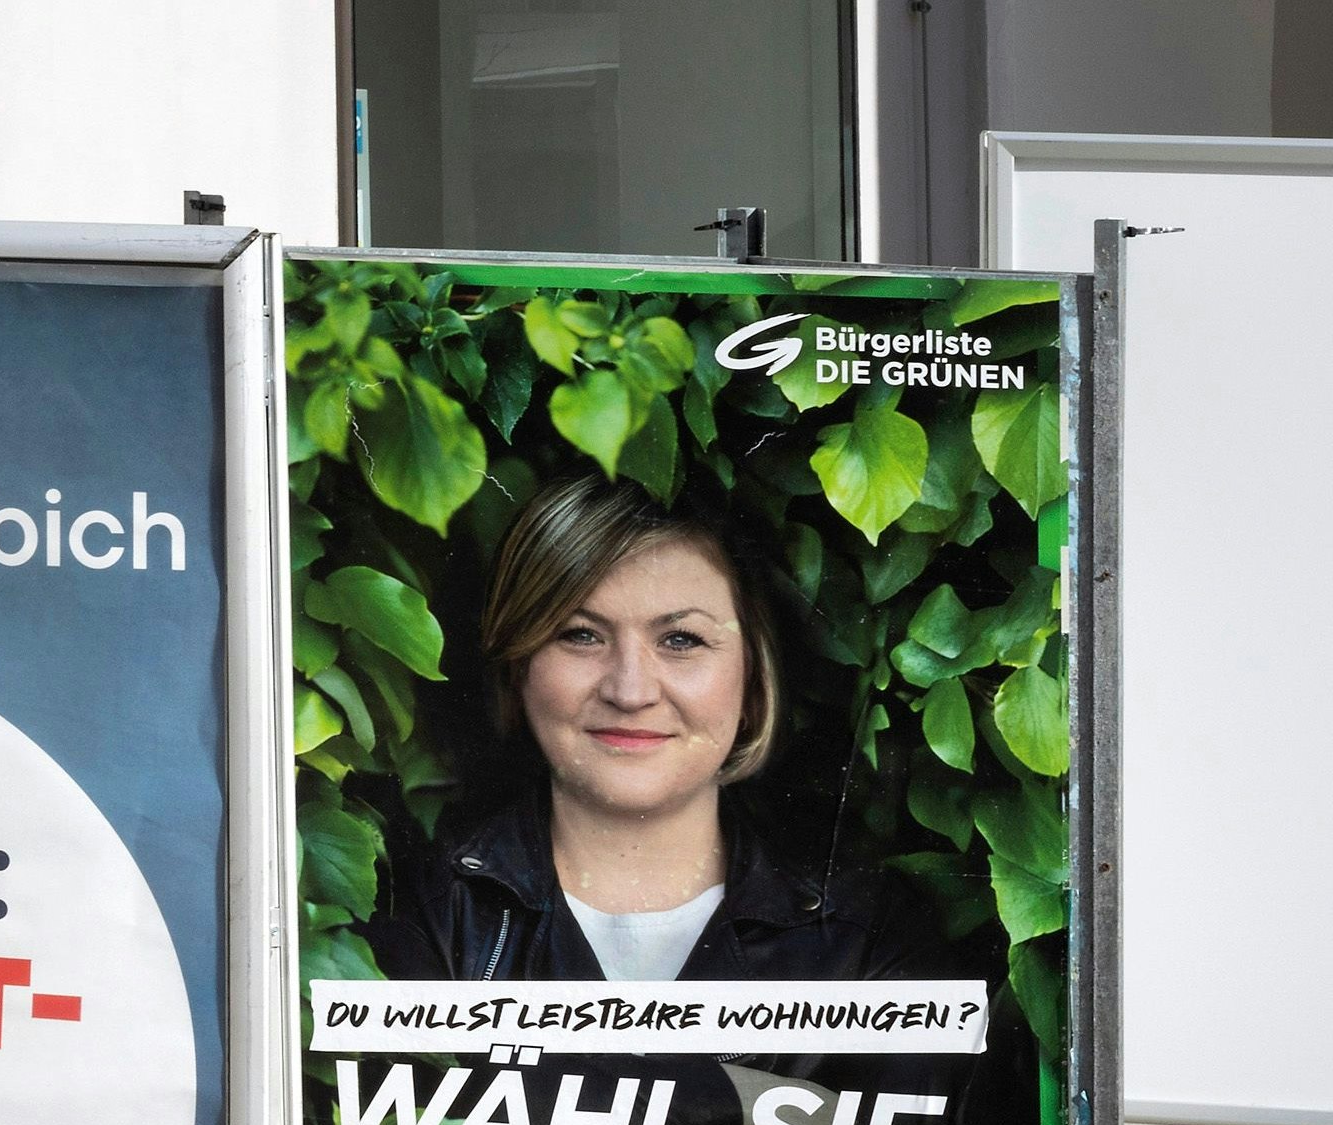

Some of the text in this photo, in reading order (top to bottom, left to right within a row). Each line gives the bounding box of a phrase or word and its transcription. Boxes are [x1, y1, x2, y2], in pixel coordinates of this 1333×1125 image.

[816, 326, 992, 357] Bürgerliste
[816, 357, 1025, 390] DIE GRÜNEN
[326, 1001, 370, 1028] DU
[383, 997, 518, 1032] WILLST
[517, 998, 703, 1032] LEISTBARE
